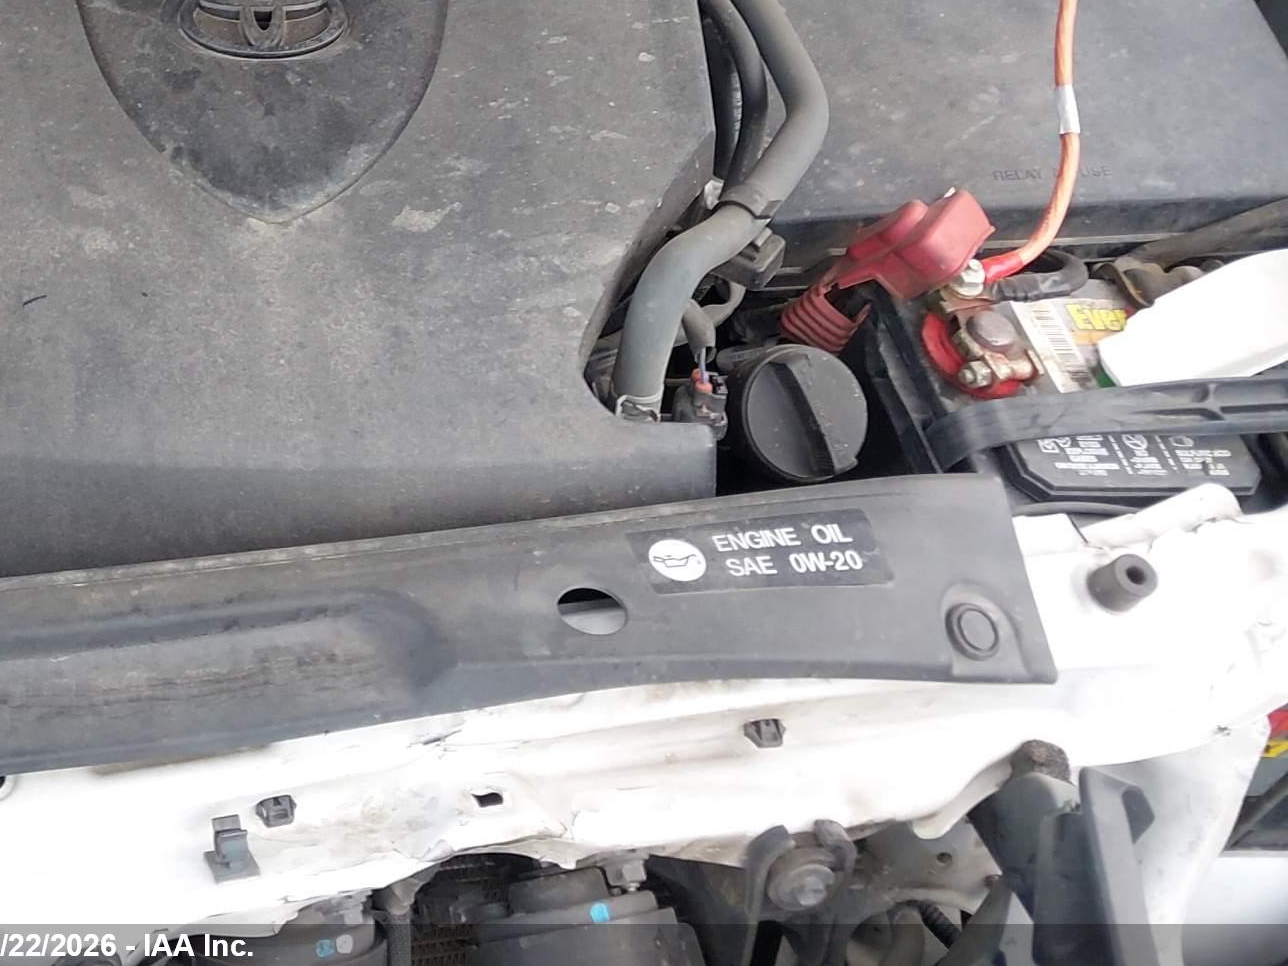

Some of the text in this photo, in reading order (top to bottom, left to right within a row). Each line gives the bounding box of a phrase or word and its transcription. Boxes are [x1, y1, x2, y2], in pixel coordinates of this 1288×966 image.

[991, 167, 1043, 182] RELAY
[711, 523, 854, 552] ENGINE OIL
[725, 549, 864, 577] SAE 0W-20
